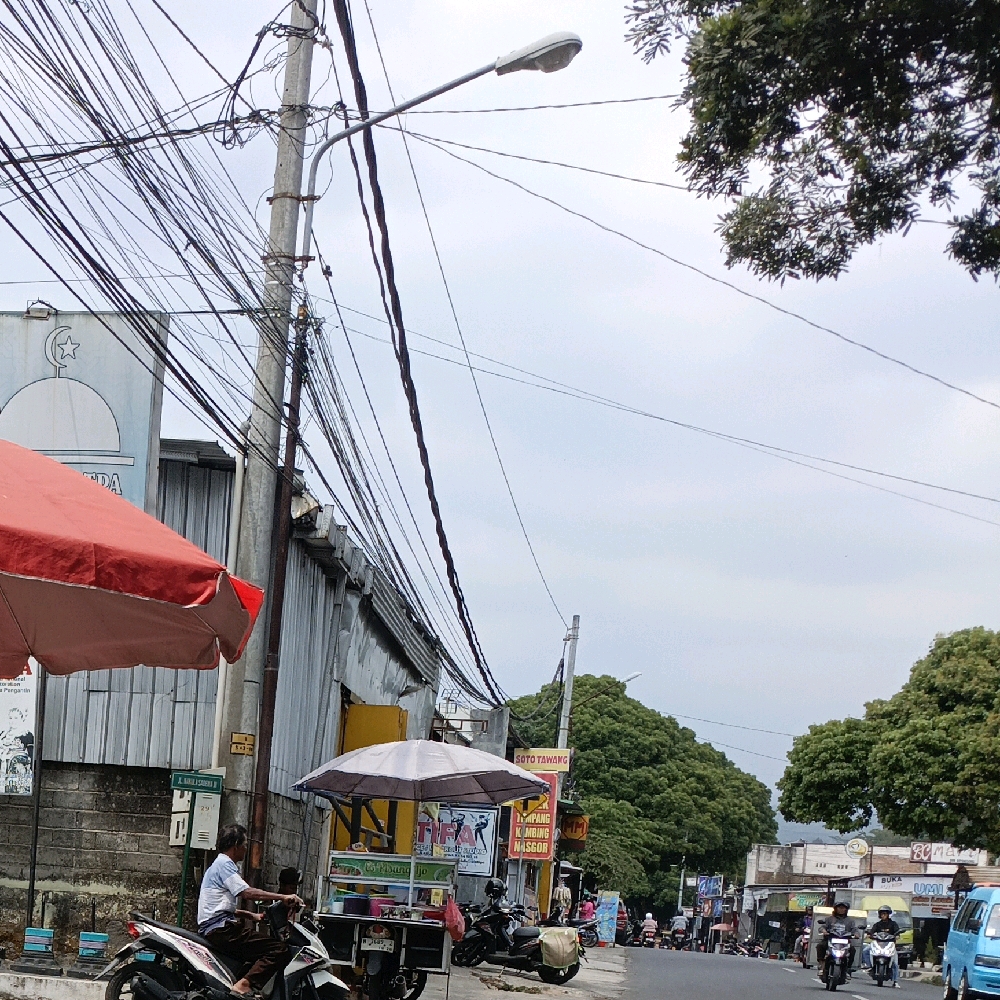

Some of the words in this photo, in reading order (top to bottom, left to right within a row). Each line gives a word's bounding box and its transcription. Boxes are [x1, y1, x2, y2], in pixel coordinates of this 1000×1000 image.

[515, 755, 536, 764] SOTO
[537, 755, 568, 765] TAWANG
[417, 821, 477, 847] TIFA
[515, 827, 550, 839] KMBING
[881, 876, 903, 884] BUKA
[913, 883, 944, 896] UMI
